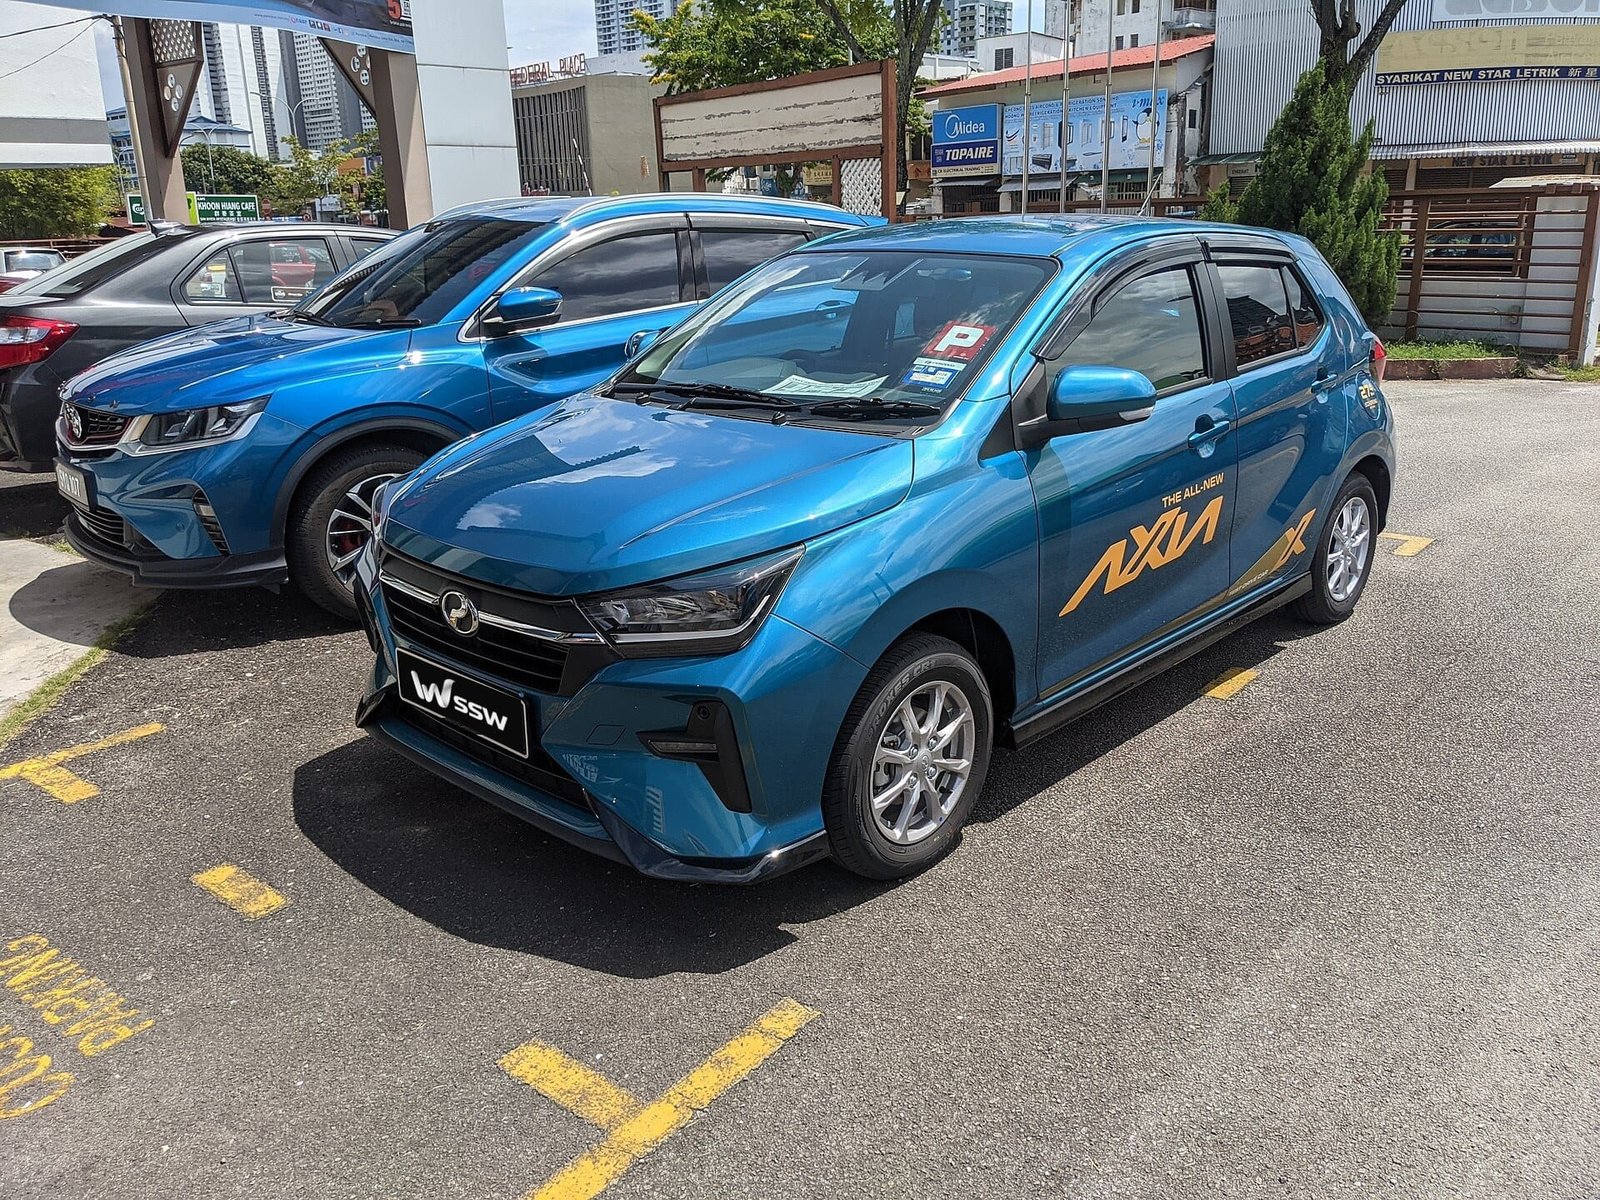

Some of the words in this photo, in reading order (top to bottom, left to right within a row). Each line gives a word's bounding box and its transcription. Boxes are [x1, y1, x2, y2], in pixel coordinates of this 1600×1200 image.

[510, 61, 553, 86] FEDERAL
[1376, 72, 1440, 85] SYARIKAT
[1443, 70, 1474, 82] NEW
[1478, 69, 1511, 80] STAR
[1516, 68, 1561, 79] LETRIK
[947, 118, 985, 136] Midea
[945, 146, 994, 161] TOPAIRE
[1452, 156, 1475, 167] NEW
[1480, 155, 1508, 166] STAR
[1513, 154, 1553, 165] LETRIK
[198, 201, 221, 211] KHOON
[221, 201, 240, 210] HIANG
[240, 201, 256, 211] CAFE
[933, 324, 985, 352] P
[1161, 491, 1182, 508] THE
[1183, 472, 1225, 500] ALL-NEW
[1059, 495, 1224, 617] AXIA
